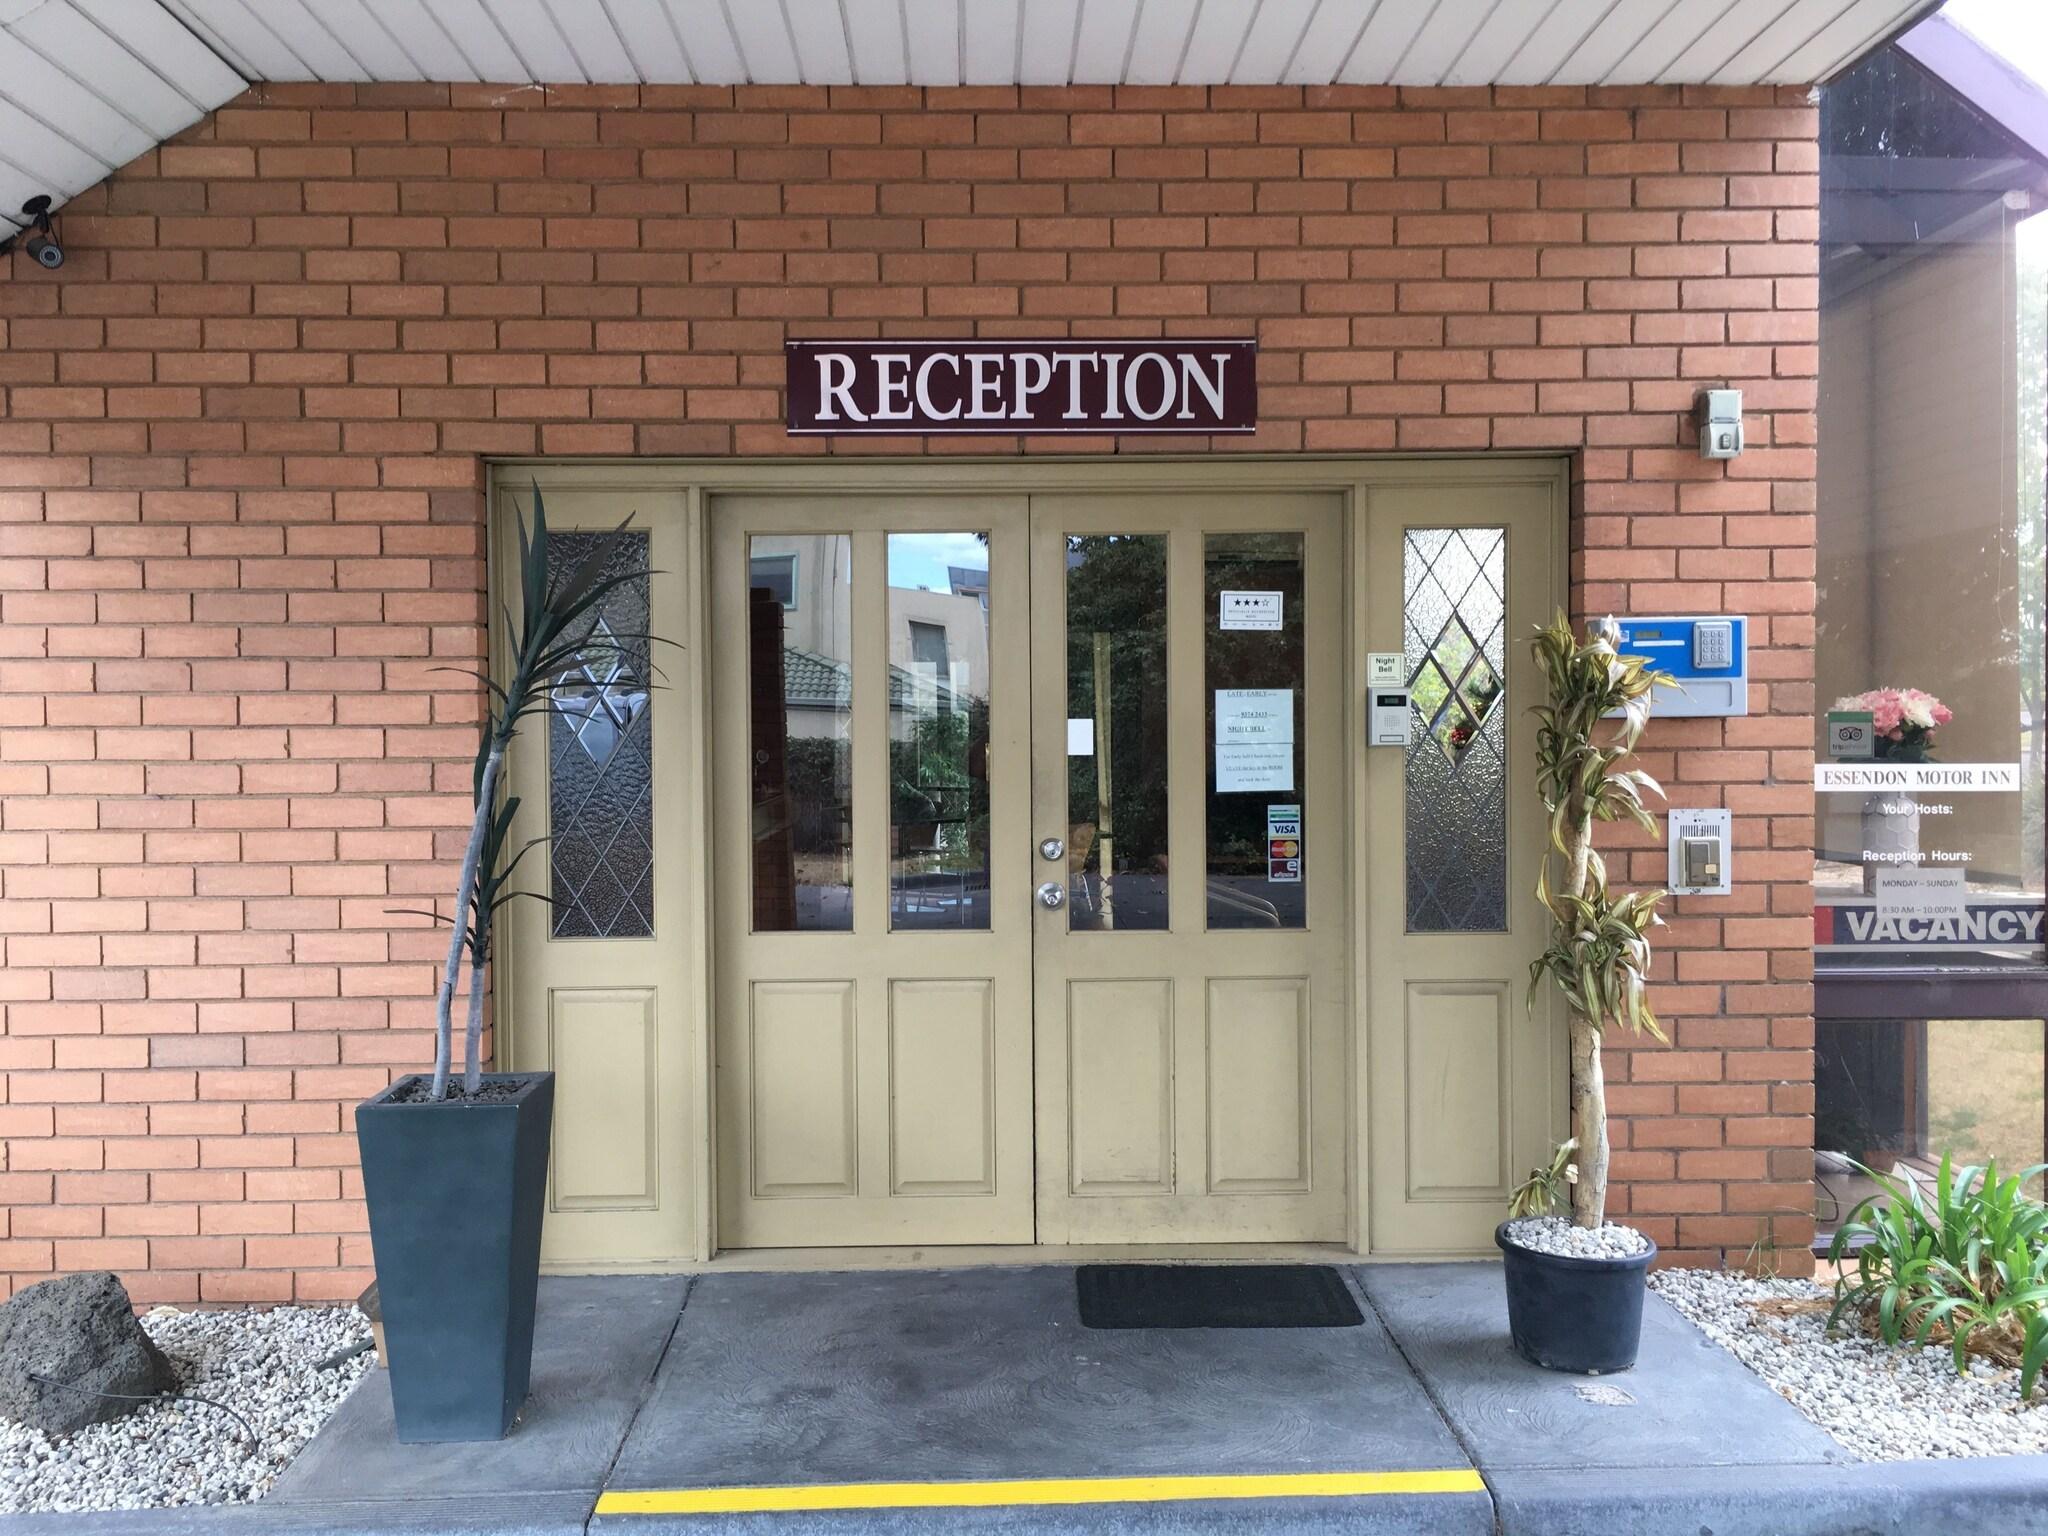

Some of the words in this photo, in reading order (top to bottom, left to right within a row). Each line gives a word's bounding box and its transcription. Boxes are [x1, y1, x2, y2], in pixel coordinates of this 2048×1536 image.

[813, 351, 1231, 422] RECEPTION
[1375, 657, 1395, 665] Night
[1823, 770, 1907, 785] ESSENDON
[1916, 770, 1972, 785] MOTOR
[1982, 770, 2011, 785] INN
[1882, 803, 1908, 815] Your
[1915, 803, 1953, 815] Hosts:
[1274, 825, 1296, 834] VISA
[1863, 850, 1926, 863] Reception
[1932, 850, 1972, 861] Hours:
[1882, 879, 1918, 887] MONDAY
[1926, 879, 1959, 887] SUNDAY
[1846, 910, 2045, 941] VACANCY
